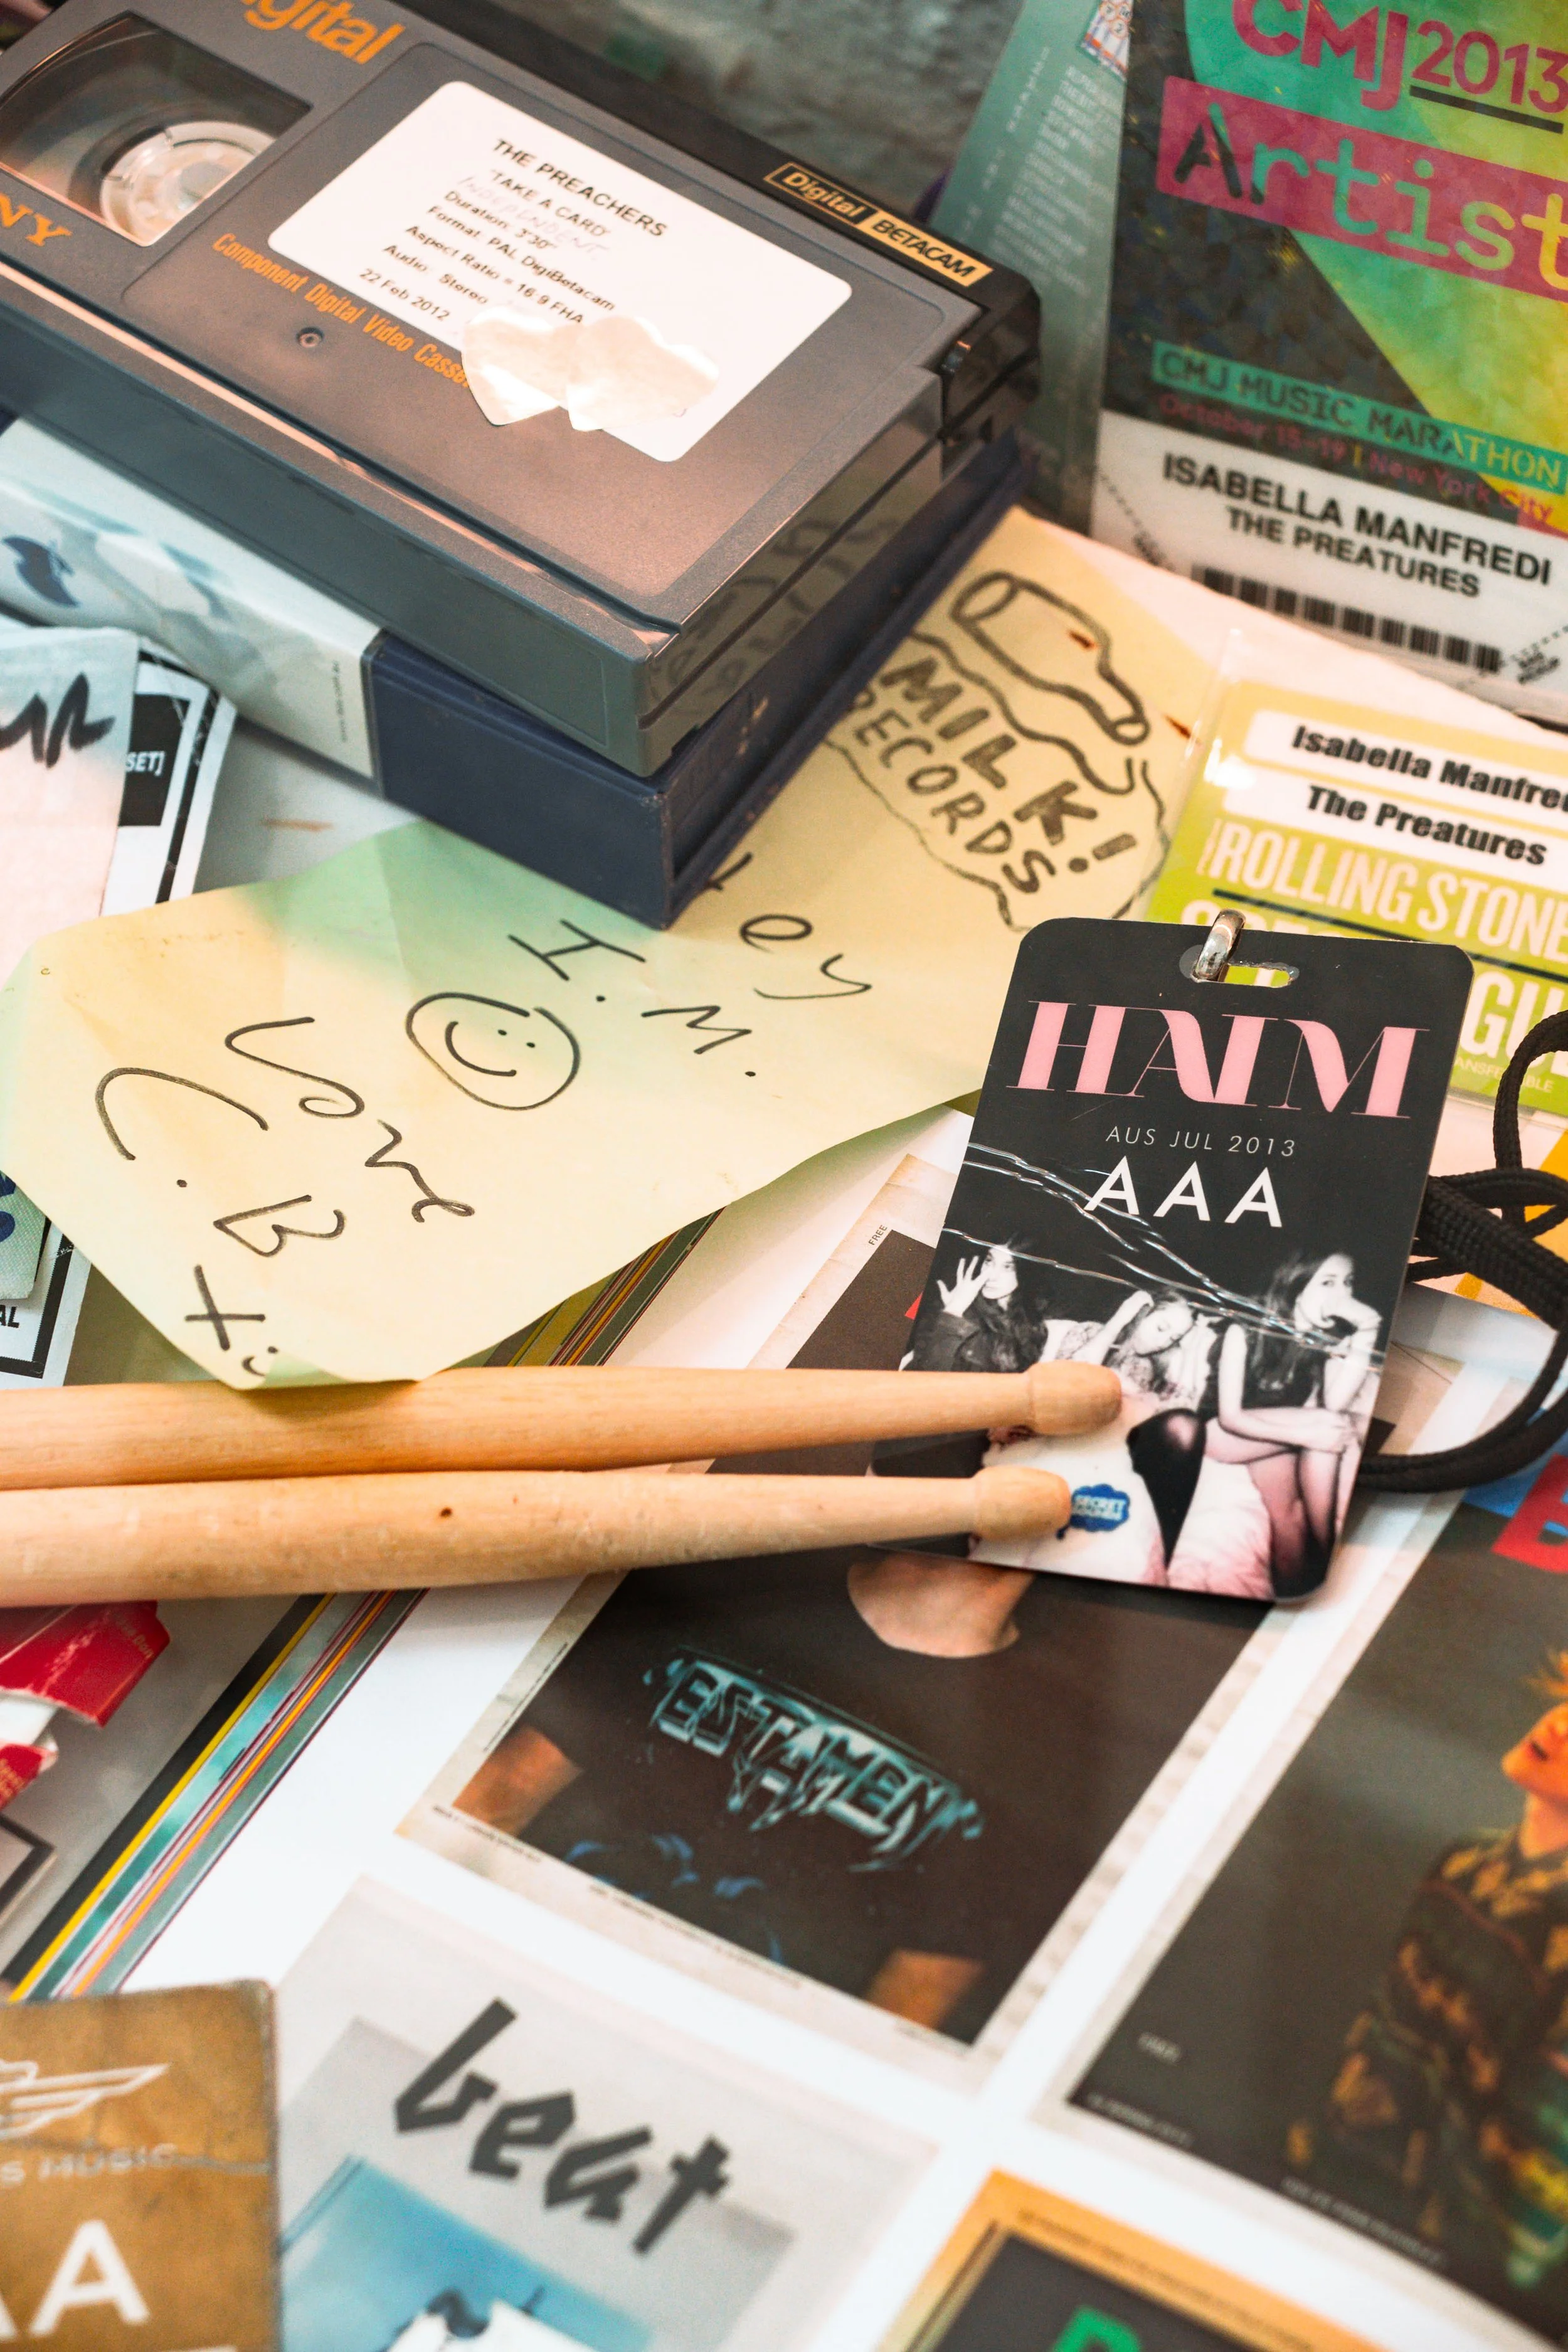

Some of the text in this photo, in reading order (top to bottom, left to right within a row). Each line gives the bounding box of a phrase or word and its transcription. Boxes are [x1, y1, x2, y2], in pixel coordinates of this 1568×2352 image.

[236, 0, 406, 65] gital
[493, 139, 667, 237] THE PREACHERS
[539, 198, 553, 208] A
[783, 171, 977, 278] Digital BETACAM
[1174, 102, 1568, 290] Artist
[212, 233, 470, 388] Component Digital Video Casse
[359, 268, 452, 322] 22 Feb 2012
[406, 225, 459, 258] Aspect
[460, 253, 501, 280] Ratio
[550, 301, 584, 324] FHA
[439, 273, 489, 305] Stereo
[487, 236, 517, 260] PAL
[521, 255, 615, 311] DigiBetacam
[1158, 393, 1267, 440] October
[1369, 450, 1429, 485] New
[1436, 467, 1491, 504] York
[1499, 486, 1556, 524] City
[1159, 349, 1562, 488] CMJ MUSIC MARATHON
[1162, 452, 1554, 587] ISABELLA MANFREDI
[1226, 506, 1481, 599] THE PREATURES
[880, 654, 1138, 874] MILK!
[1290, 724, 1568, 812] Isabella Manfre
[1200, 819, 1420, 925] ROLLING
[1306, 784, 1549, 867] The Preatures
[1005, 999, 1431, 1120] HAIM
[1105, 1125, 1295, 1157] AUS JUL 2013
[867, 1224, 888, 1246] FREE
[1083, 1155, 1283, 1228] AAA
[38, 2142, 179, 2180] MUSIC
[395, 1996, 732, 2258] beat
